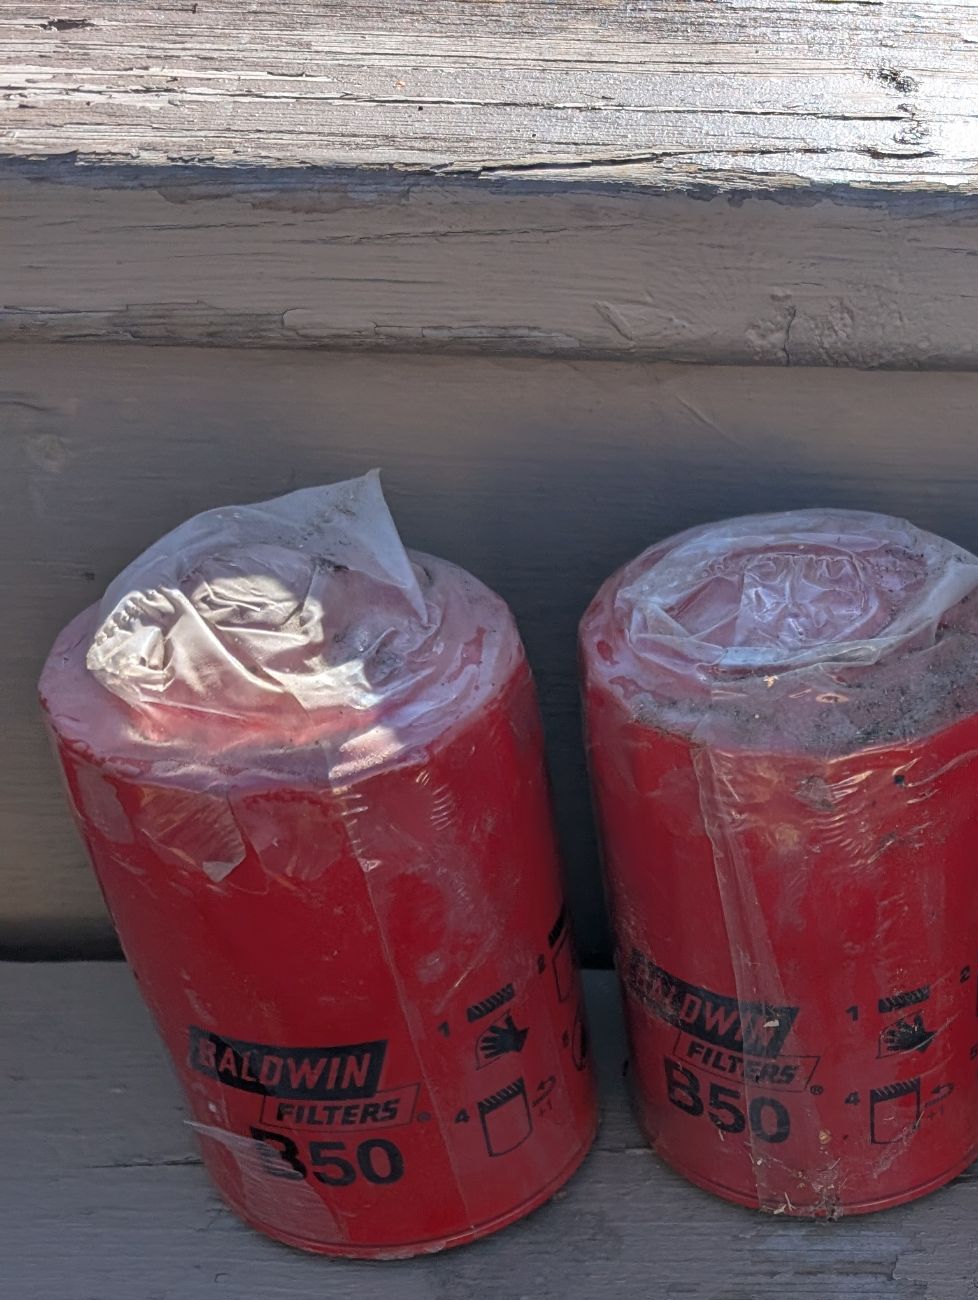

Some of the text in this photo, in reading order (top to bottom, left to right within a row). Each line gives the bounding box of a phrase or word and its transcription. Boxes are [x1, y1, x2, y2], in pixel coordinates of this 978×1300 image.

[845, 1005, 859, 1021] 1
[198, 1038, 371, 1089] BALDWIN
[687, 1041, 801, 1084] FILTERS
[277, 1098, 400, 1125] FILTERS
[664, 1056, 790, 1144] B50
[844, 1091, 860, 1104] 4
[250, 1126, 405, 1187] B50
